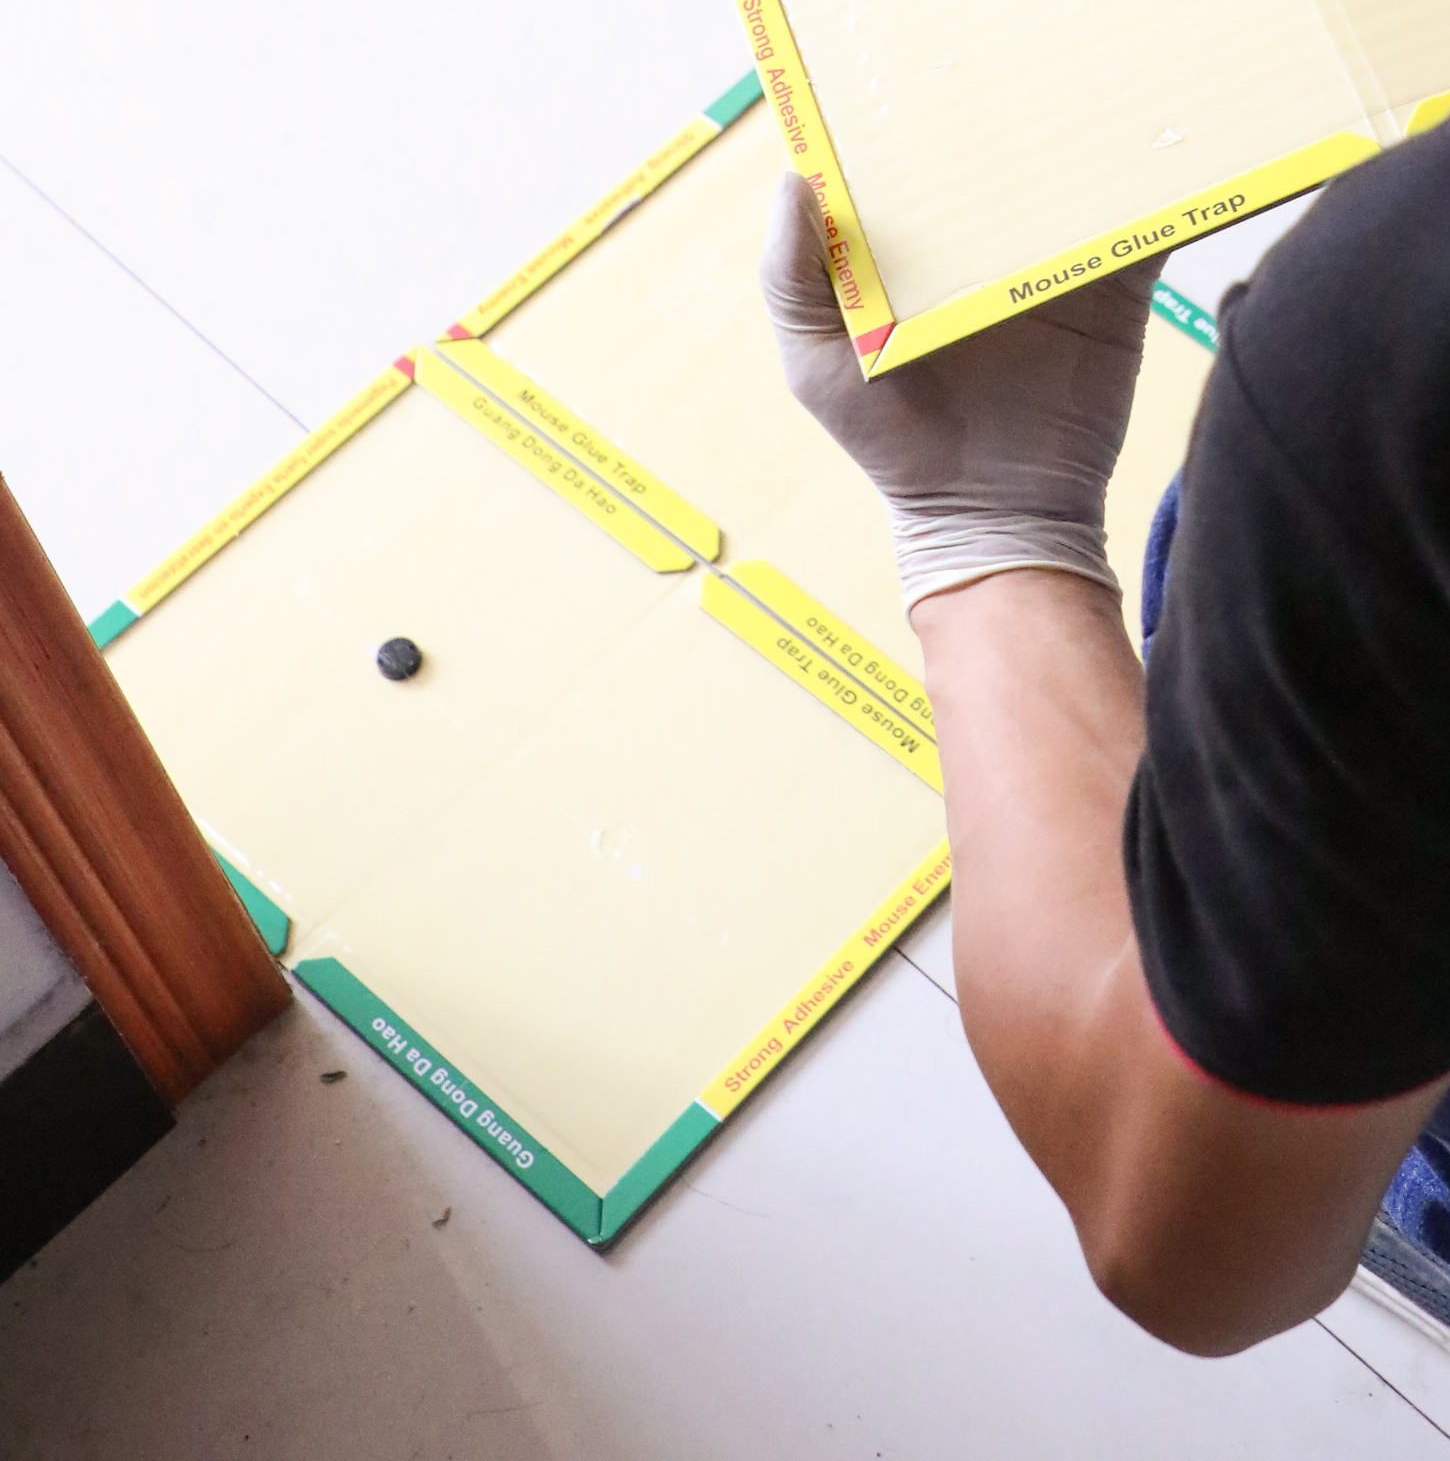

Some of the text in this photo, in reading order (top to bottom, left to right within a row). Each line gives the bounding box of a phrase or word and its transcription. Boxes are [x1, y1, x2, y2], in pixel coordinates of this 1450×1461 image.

[767, 67, 808, 155] Adhesive
[829, 240, 865, 310] Enemy
[1009, 193, 1246, 303] Mouse Glue Trap
[1154, 290, 1191, 323] Trap
[473, 397, 616, 514] Guang Dong Da Hao
[519, 390, 646, 495] Mouse Glue Trap
[777, 638, 813, 672] Trap
[807, 618, 909, 703] Dong Da Hao
[819, 670, 857, 705] Glue
[862, 704, 920, 753] Mouse
[724, 1037, 782, 1093] Strong
[783, 960, 854, 1034] Adhesive
[863, 896, 916, 947] Mouse
[372, 1017, 534, 1169] Guang Dong Da Hao
